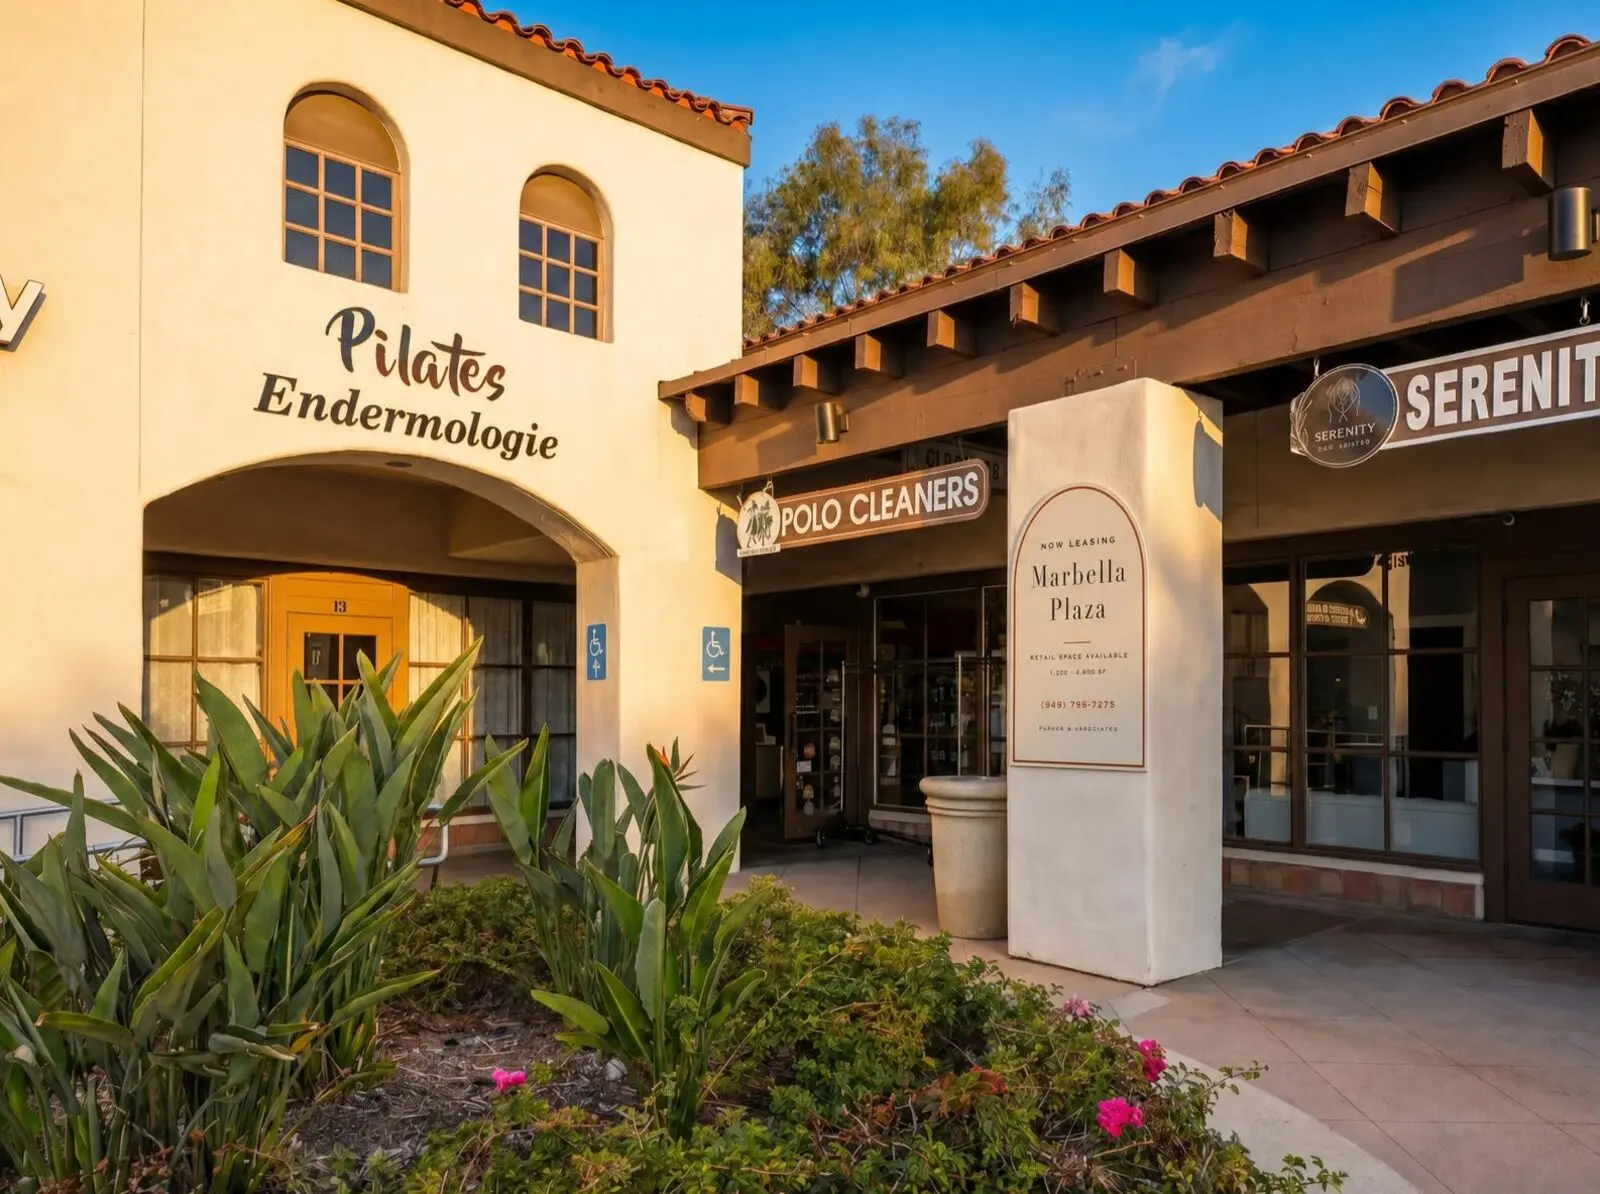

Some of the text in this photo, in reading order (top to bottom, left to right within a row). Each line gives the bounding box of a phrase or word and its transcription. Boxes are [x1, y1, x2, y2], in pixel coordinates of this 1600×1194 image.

[325, 306, 506, 401] Pilates
[253, 372, 558, 461] Endermologie
[1314, 422, 1376, 442] SERENITY
[781, 498, 842, 537] POLO
[849, 471, 979, 526] CLEANERS
[1041, 536, 1116, 550] NOW LEASING
[1032, 559, 1126, 588] Marbella
[1050, 597, 1106, 621] Plaza
[1029, 651, 1128, 661] RETAIL SPACE AVAILABLE
